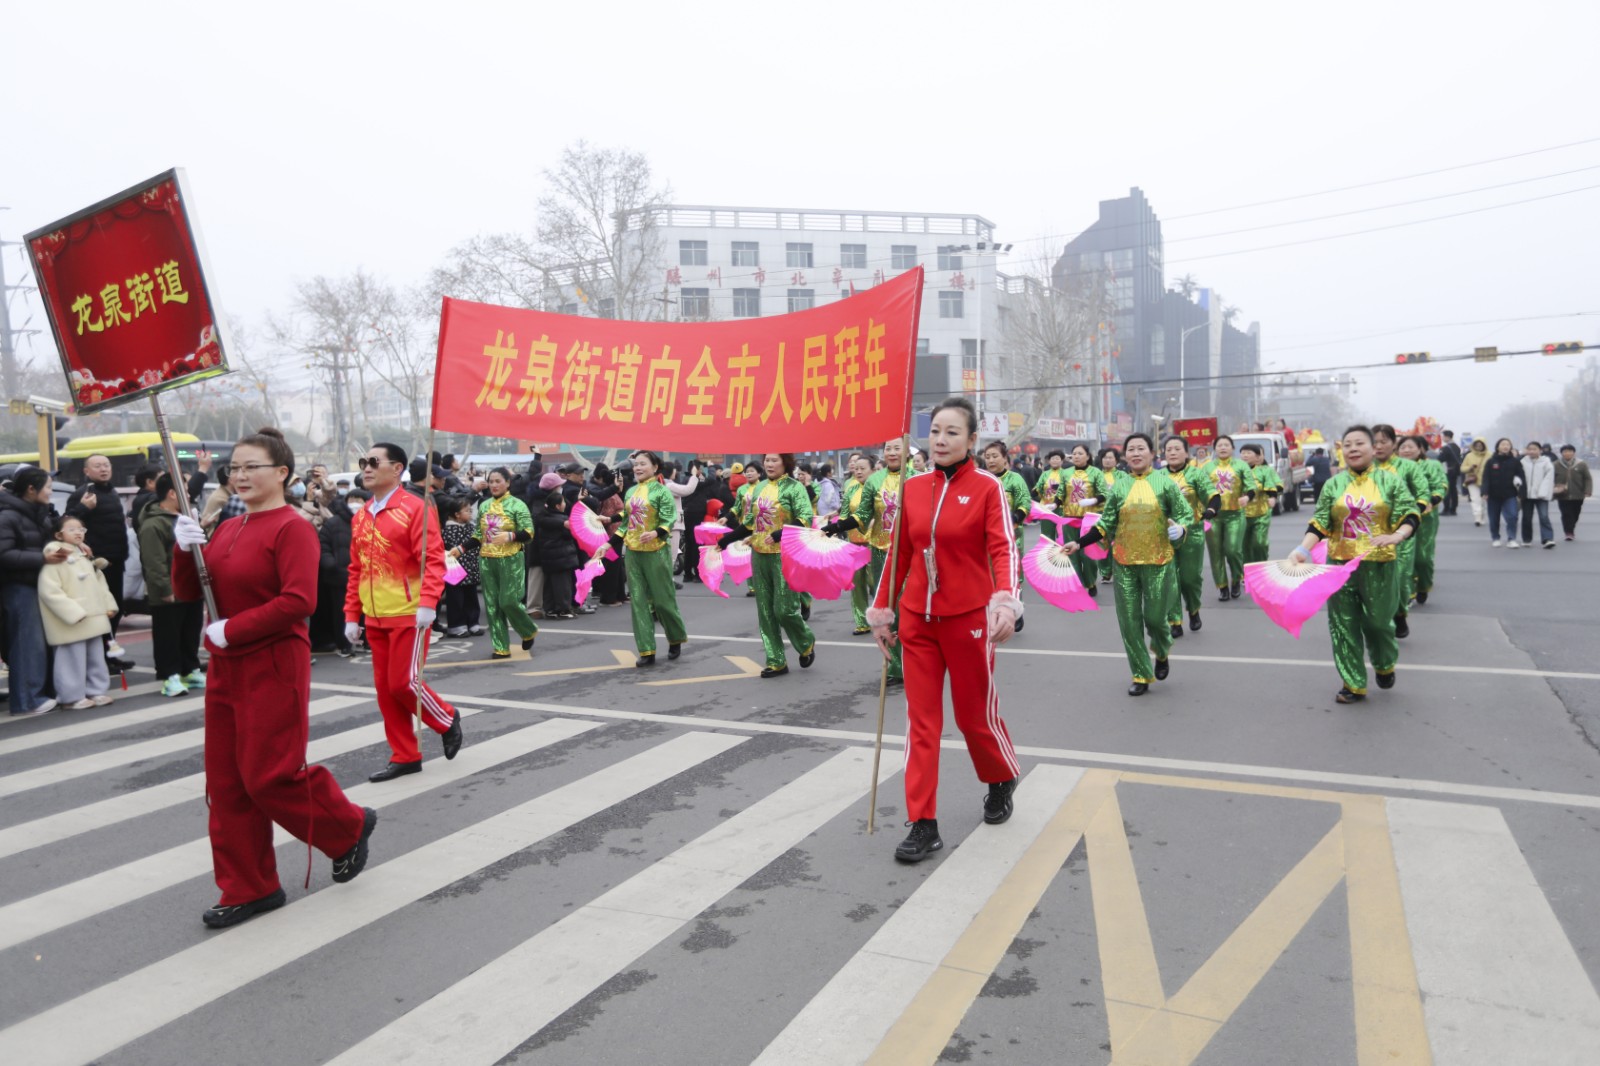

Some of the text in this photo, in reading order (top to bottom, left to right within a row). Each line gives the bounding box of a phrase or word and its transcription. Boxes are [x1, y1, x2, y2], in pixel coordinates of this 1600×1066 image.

[71, 259, 189, 335] 龙泉街道
[475, 318, 889, 428] 龙泉街道向全市人民拜年
